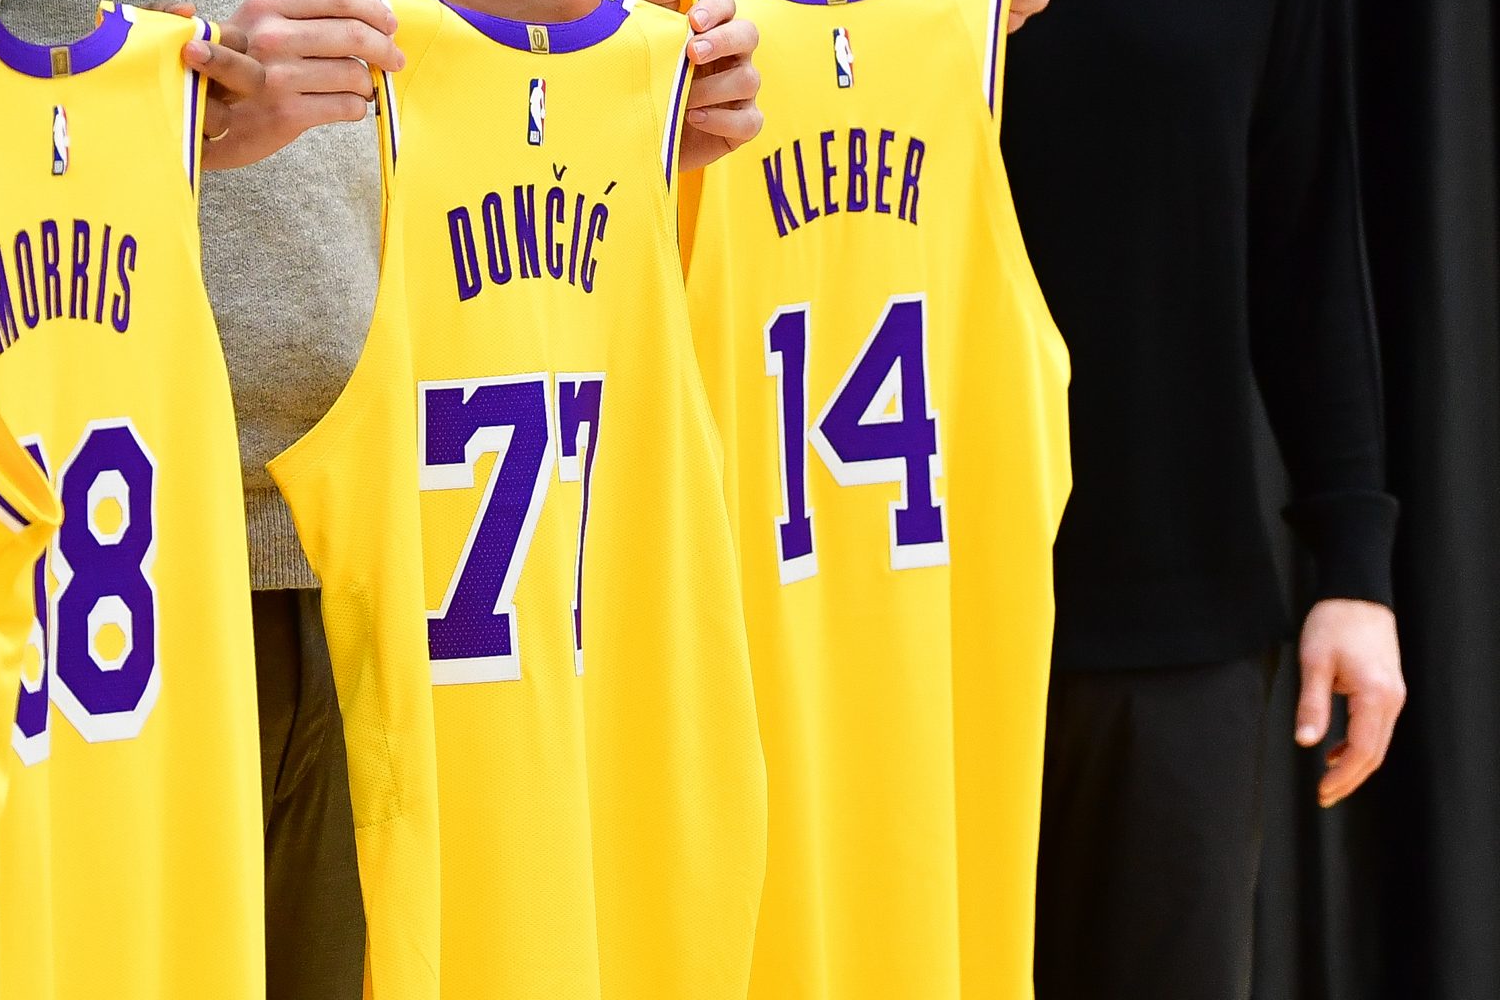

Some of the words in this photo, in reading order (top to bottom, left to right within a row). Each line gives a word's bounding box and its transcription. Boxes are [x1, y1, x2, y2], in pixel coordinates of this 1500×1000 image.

[447, 162, 618, 302] DONČIĆ
[762, 128, 925, 238] KLEBER
[418, 371, 606, 686] 77
[763, 291, 950, 586] 14
